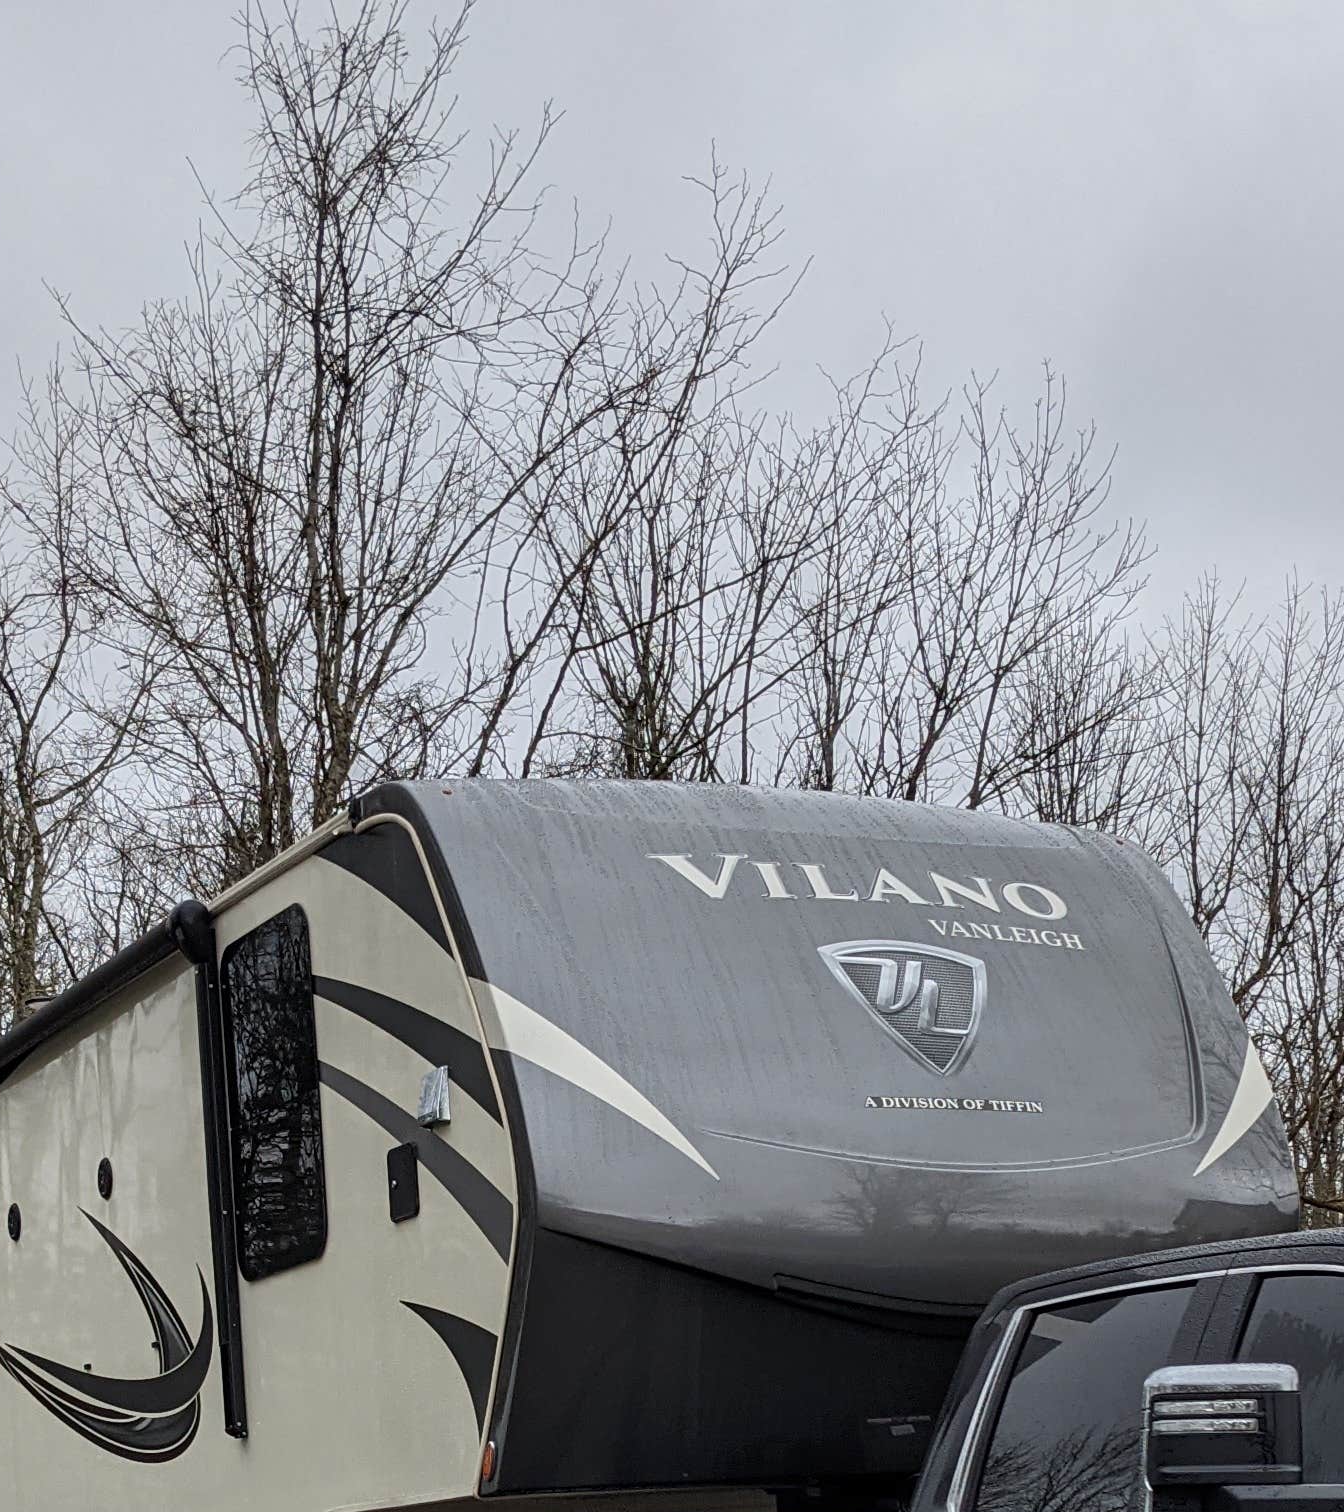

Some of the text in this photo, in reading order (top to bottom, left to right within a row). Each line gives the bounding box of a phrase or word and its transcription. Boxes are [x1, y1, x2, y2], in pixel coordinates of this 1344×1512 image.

[647, 853, 1068, 920] VILANO
[928, 919, 1085, 951] VANLEIGH
[865, 1096, 1044, 1113] A DIVISION OF TIFFIN
